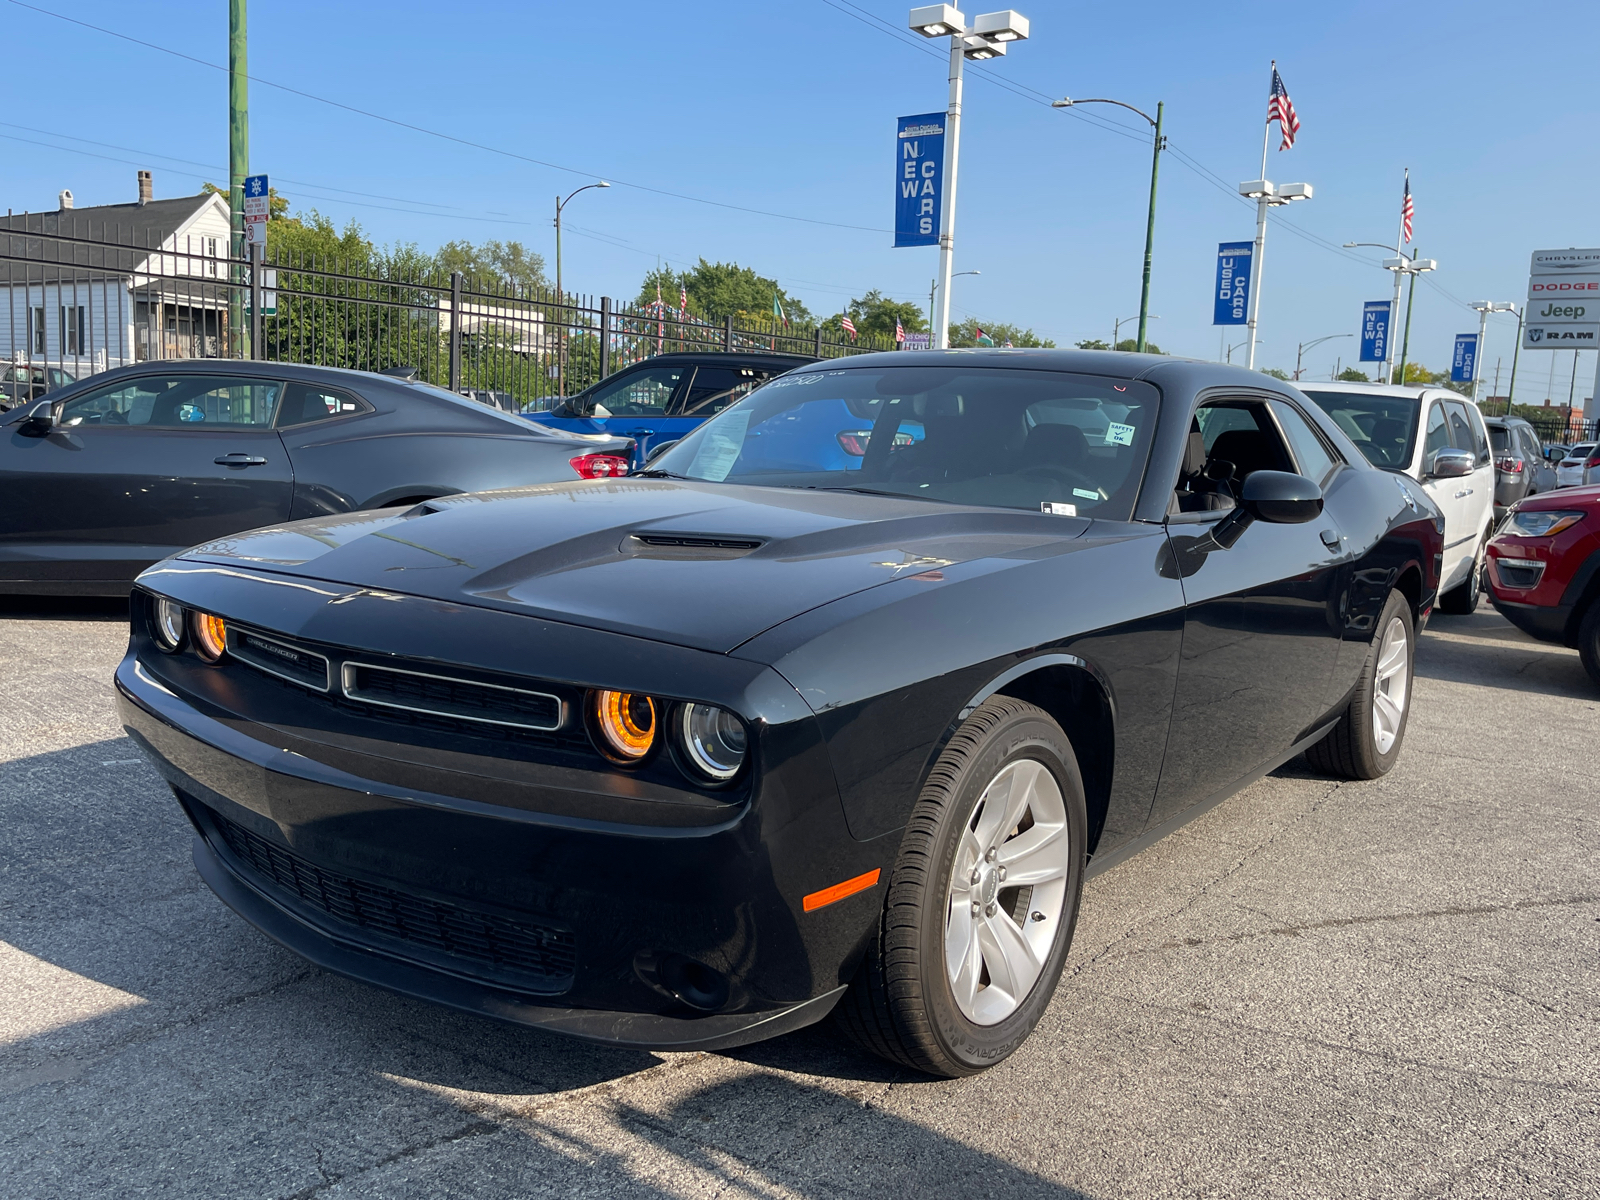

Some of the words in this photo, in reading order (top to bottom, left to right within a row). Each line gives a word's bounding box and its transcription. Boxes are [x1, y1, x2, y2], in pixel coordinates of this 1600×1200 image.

[901, 141, 919, 198] NEW
[919, 161, 936, 235] CARS
[1220, 258, 1233, 300] USED
[1532, 282, 1599, 291] DODGE
[1232, 276, 1246, 318] CARS
[1540, 303, 1585, 320] Jeep
[1365, 313, 1375, 340] NEW
[1546, 332, 1594, 340] RAM
[1374, 323, 1385, 357] CARS
[1455, 343, 1465, 367] USED
[1463, 353, 1473, 379] CARS
[1110, 424, 1133, 433] SAFETY
[246, 637, 298, 661] CHALLENGER
[965, 1028, 1026, 1060] SUREDRIVE
